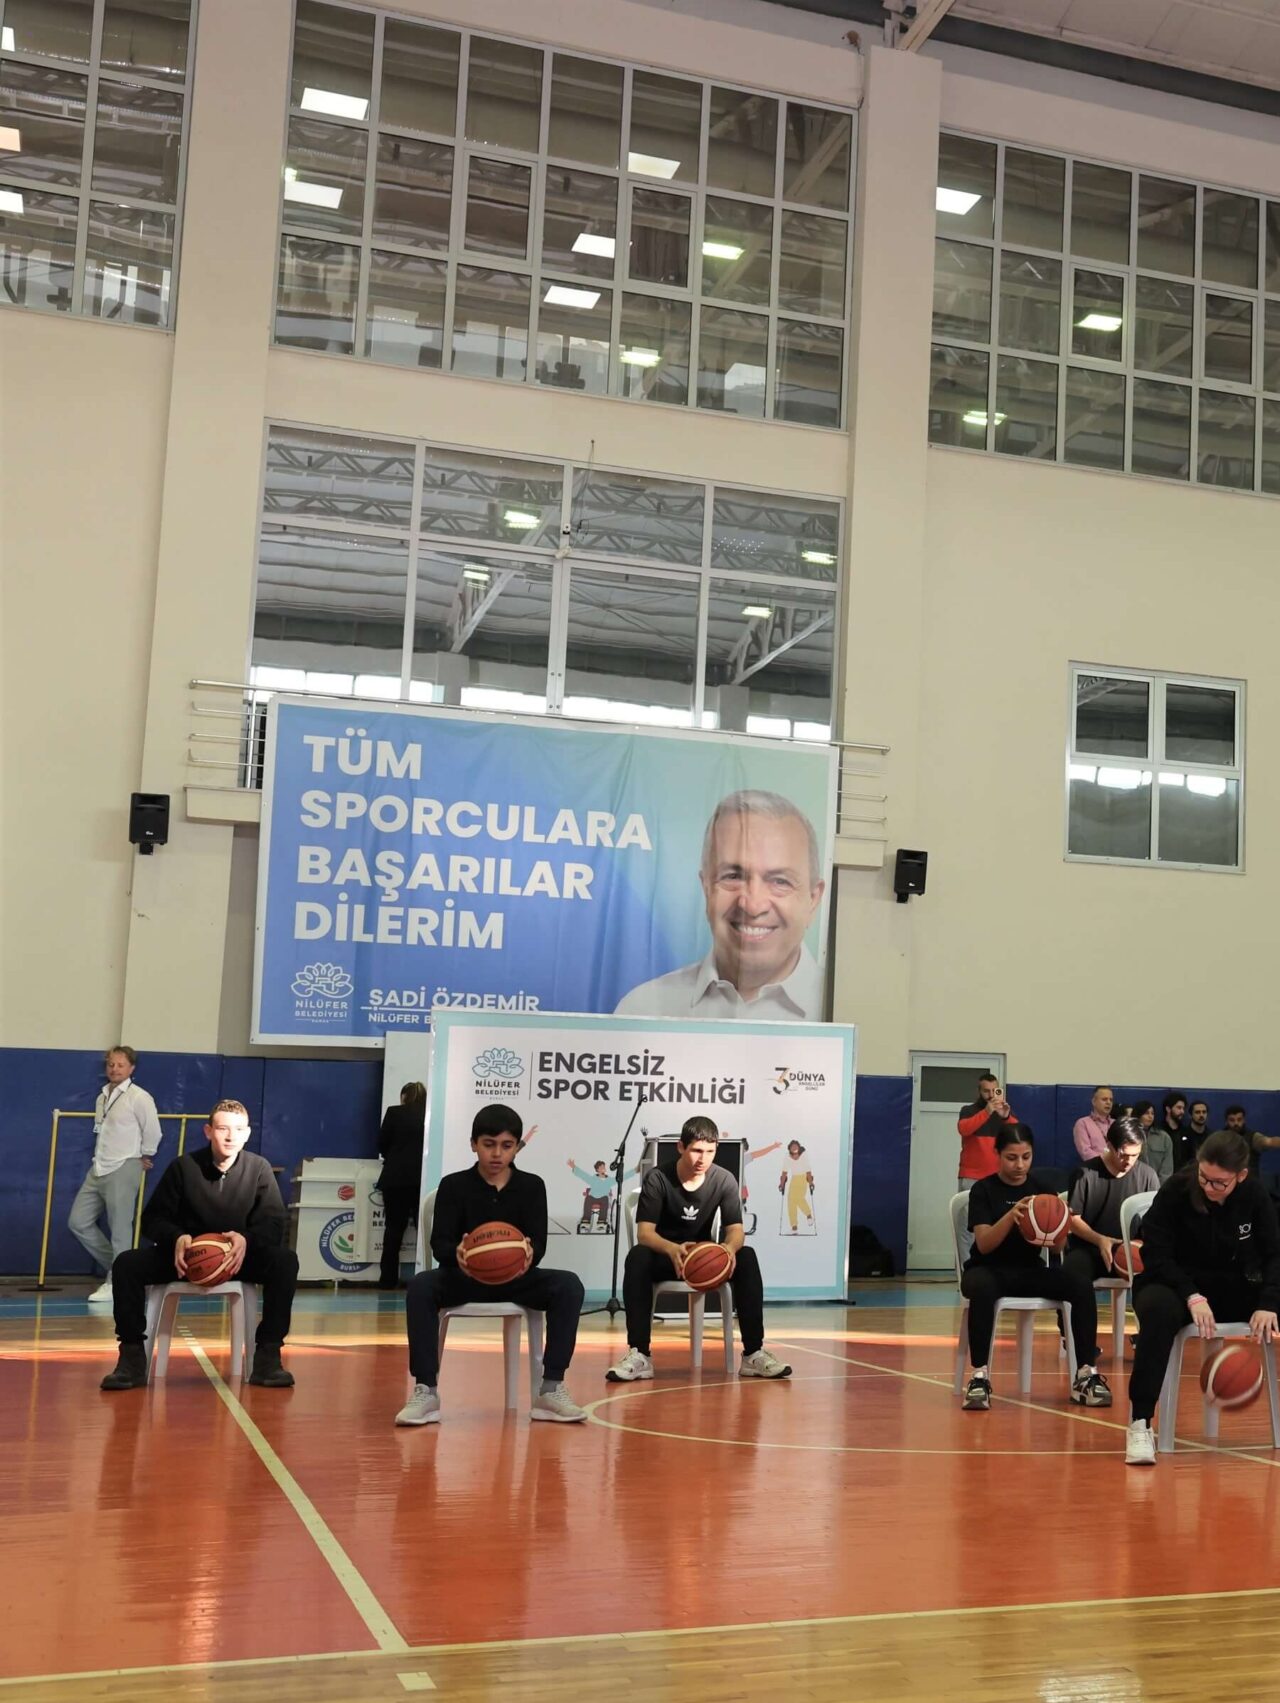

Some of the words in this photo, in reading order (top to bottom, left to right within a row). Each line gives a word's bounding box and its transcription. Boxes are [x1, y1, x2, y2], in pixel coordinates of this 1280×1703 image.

[303, 727, 423, 780] TÜM
[300, 789, 652, 851] SPORCULARA
[296, 845, 593, 902] BAŞARILAR
[293, 893, 504, 949] DİLERİM
[295, 999, 349, 1010] NİLÜFER
[432, 987, 541, 1011] ÖZDEMİR
[294, 1010, 348, 1018] BELEDİYESİ
[368, 1012, 420, 1025] NİLÜFER
[538, 1048, 666, 1076] ENGELSİZ
[475, 1079, 521, 1089] NİLÜFER
[789, 1070, 826, 1082] DÜNYA
[475, 1088, 519, 1096] BELEDİYESİ
[537, 1078, 610, 1101] SPOR
[619, 1076, 746, 1105] ETKİNLİĞİ
